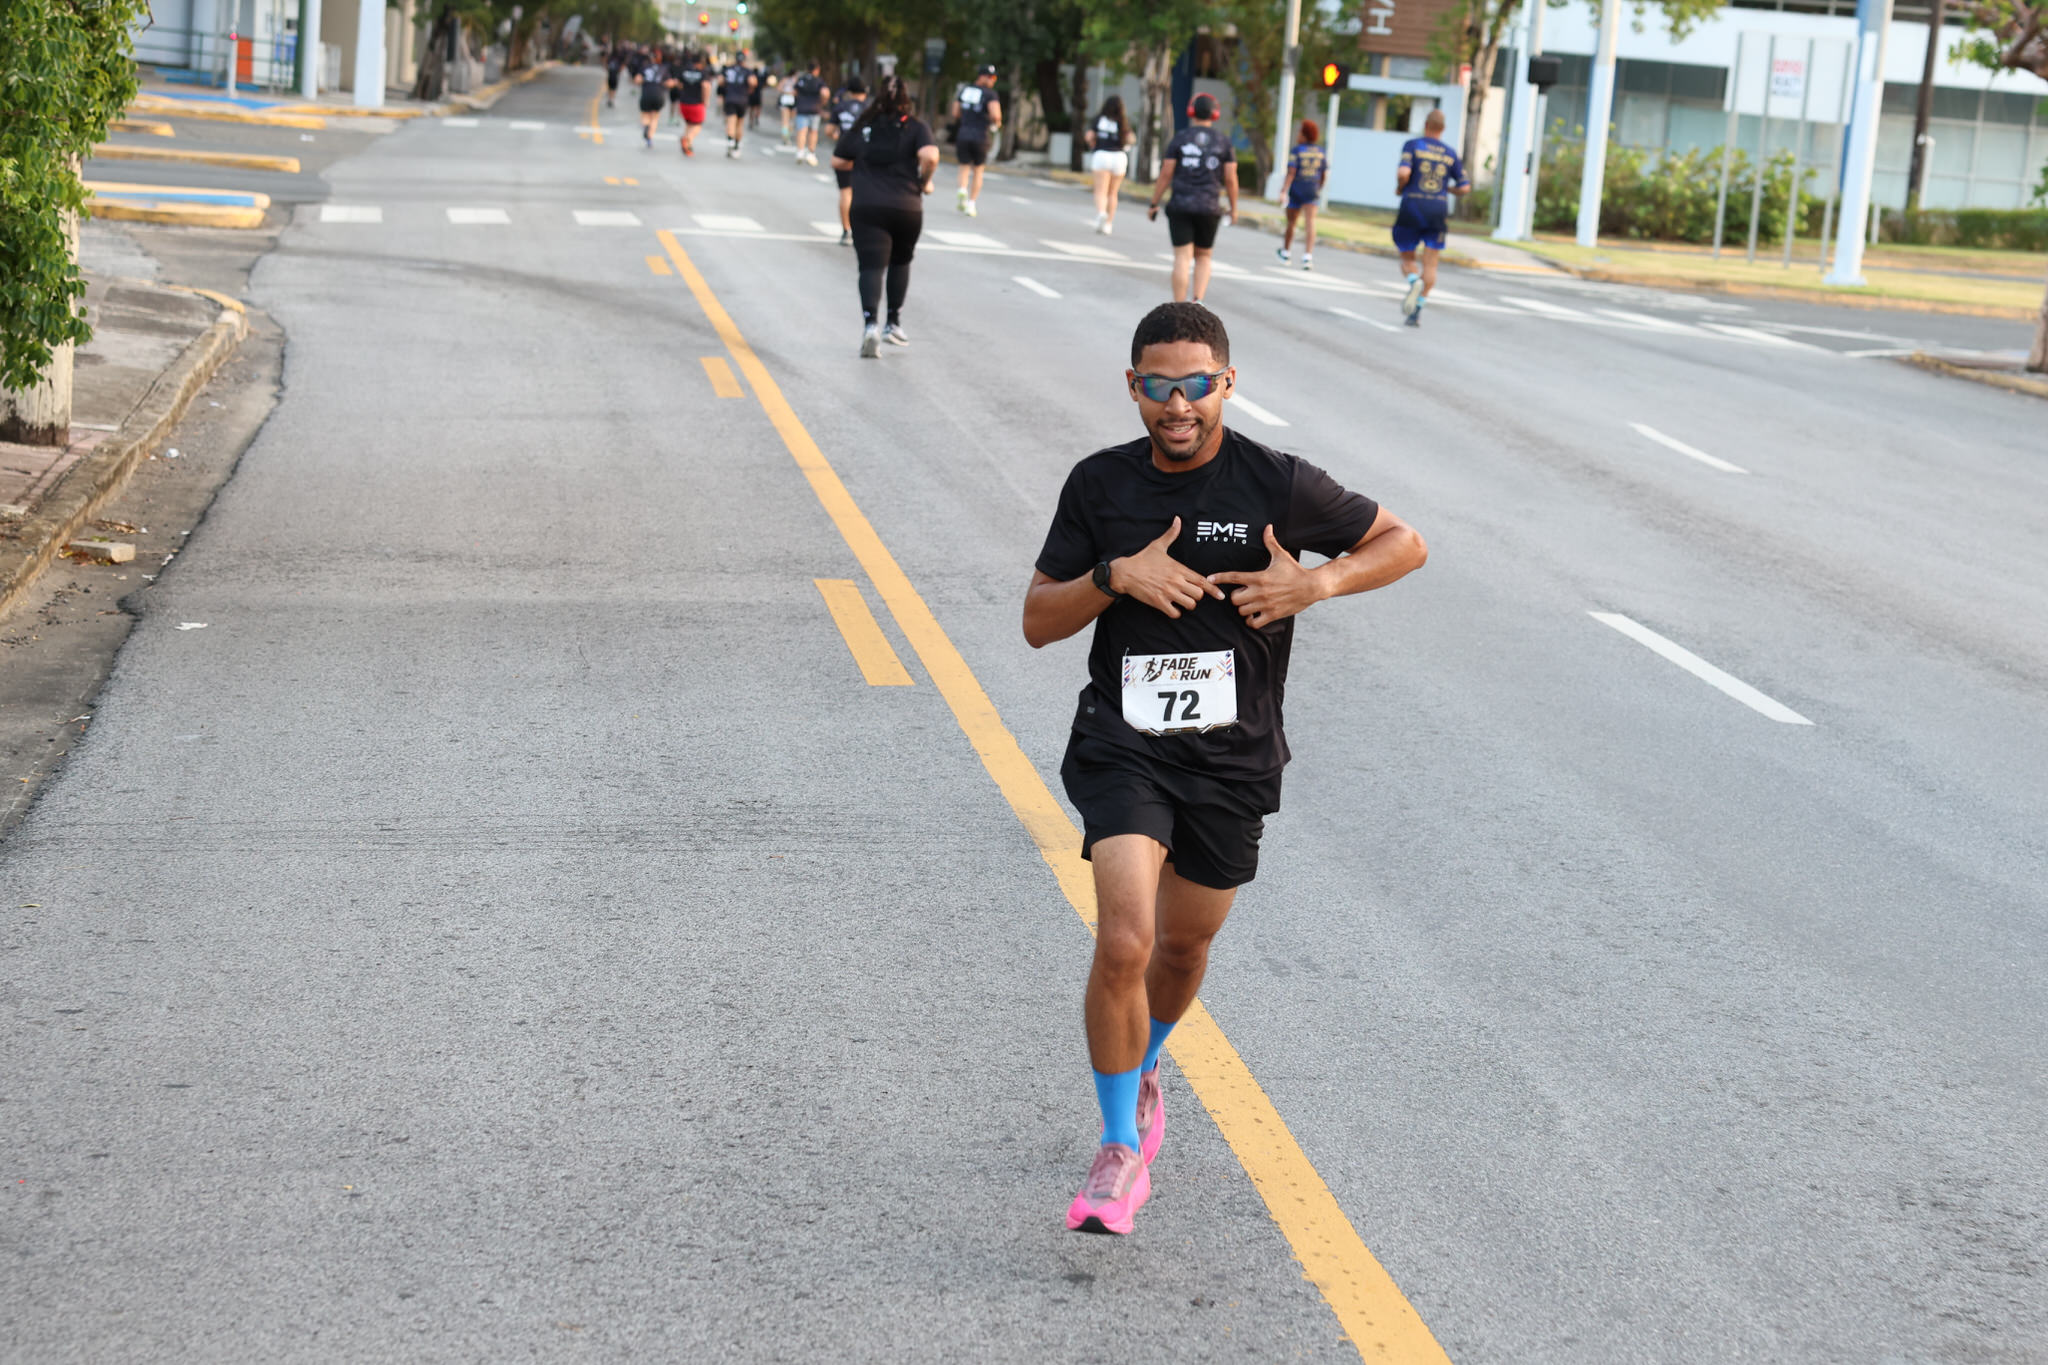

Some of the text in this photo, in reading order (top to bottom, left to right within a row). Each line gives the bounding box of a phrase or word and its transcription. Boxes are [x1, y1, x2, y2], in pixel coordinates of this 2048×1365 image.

[1197, 521, 1248, 537] EME
[1160, 657, 1198, 671] FADE
[1170, 669, 1211, 681] & RUN
[1157, 690, 1201, 722] 72
